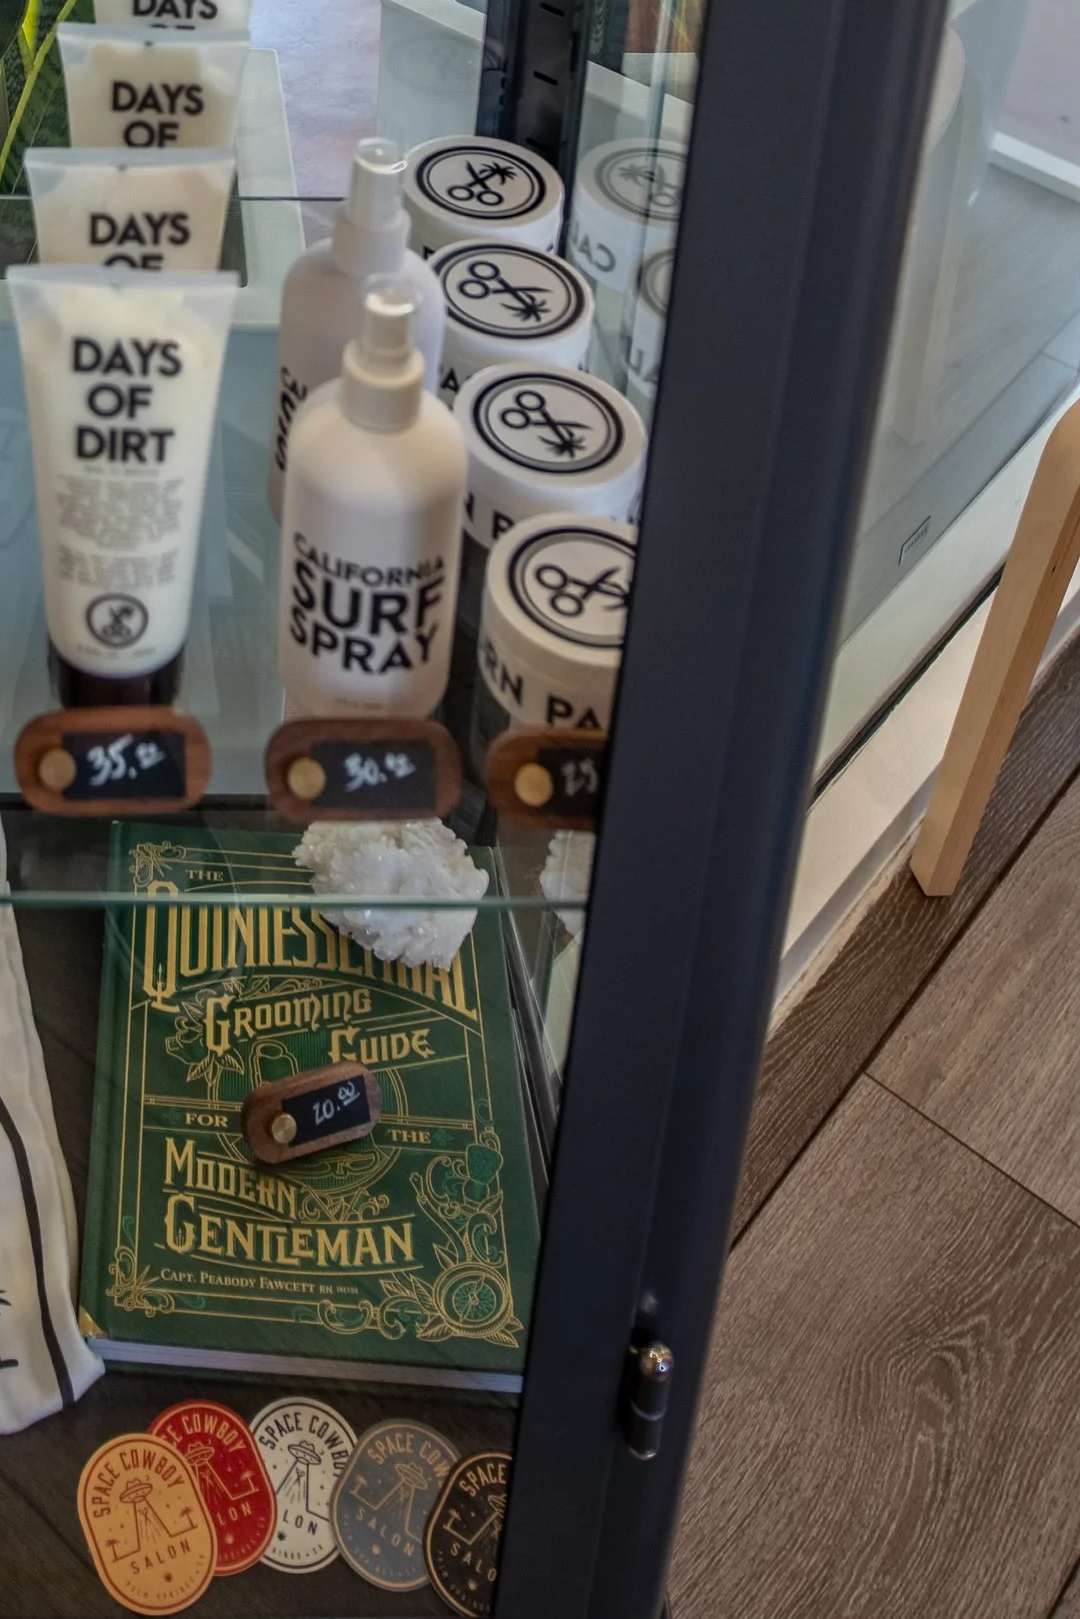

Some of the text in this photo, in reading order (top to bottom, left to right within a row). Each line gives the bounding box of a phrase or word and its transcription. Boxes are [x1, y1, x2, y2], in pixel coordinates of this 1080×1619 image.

[110, 80, 206, 117] DAYS
[122, 119, 180, 149] OF
[88, 211, 192, 247] DAYS
[71, 336, 183, 379] DAYS
[86, 382, 153, 421] OF
[76, 427, 175, 464] DIRT
[293, 532, 445, 588] CALIFORNIA
[292, 558, 445, 636] SURF
[289, 604, 439, 675] SPRAY
[185, 868, 224, 882] THE
[185, 1111, 431, 1145] FOR THE
[163, 1137, 299, 1220] MODERN
[163, 1193, 415, 1268] GENTLEMAN
[160, 1267, 197, 1284] CAPT.
[200, 1272, 257, 1290] PEABODY
[259, 1276, 316, 1294] FAWCETT
[181, 1412, 247, 1453] COWBOY
[259, 1411, 303, 1451] SPACE
[367, 1433, 414, 1465] SPACE
[92, 1448, 184, 1519] SPACE COWBOY
[458, 1463, 507, 1497] SPACE
[355, 1508, 416, 1558] SALON
[130, 1539, 192, 1576] SALON
